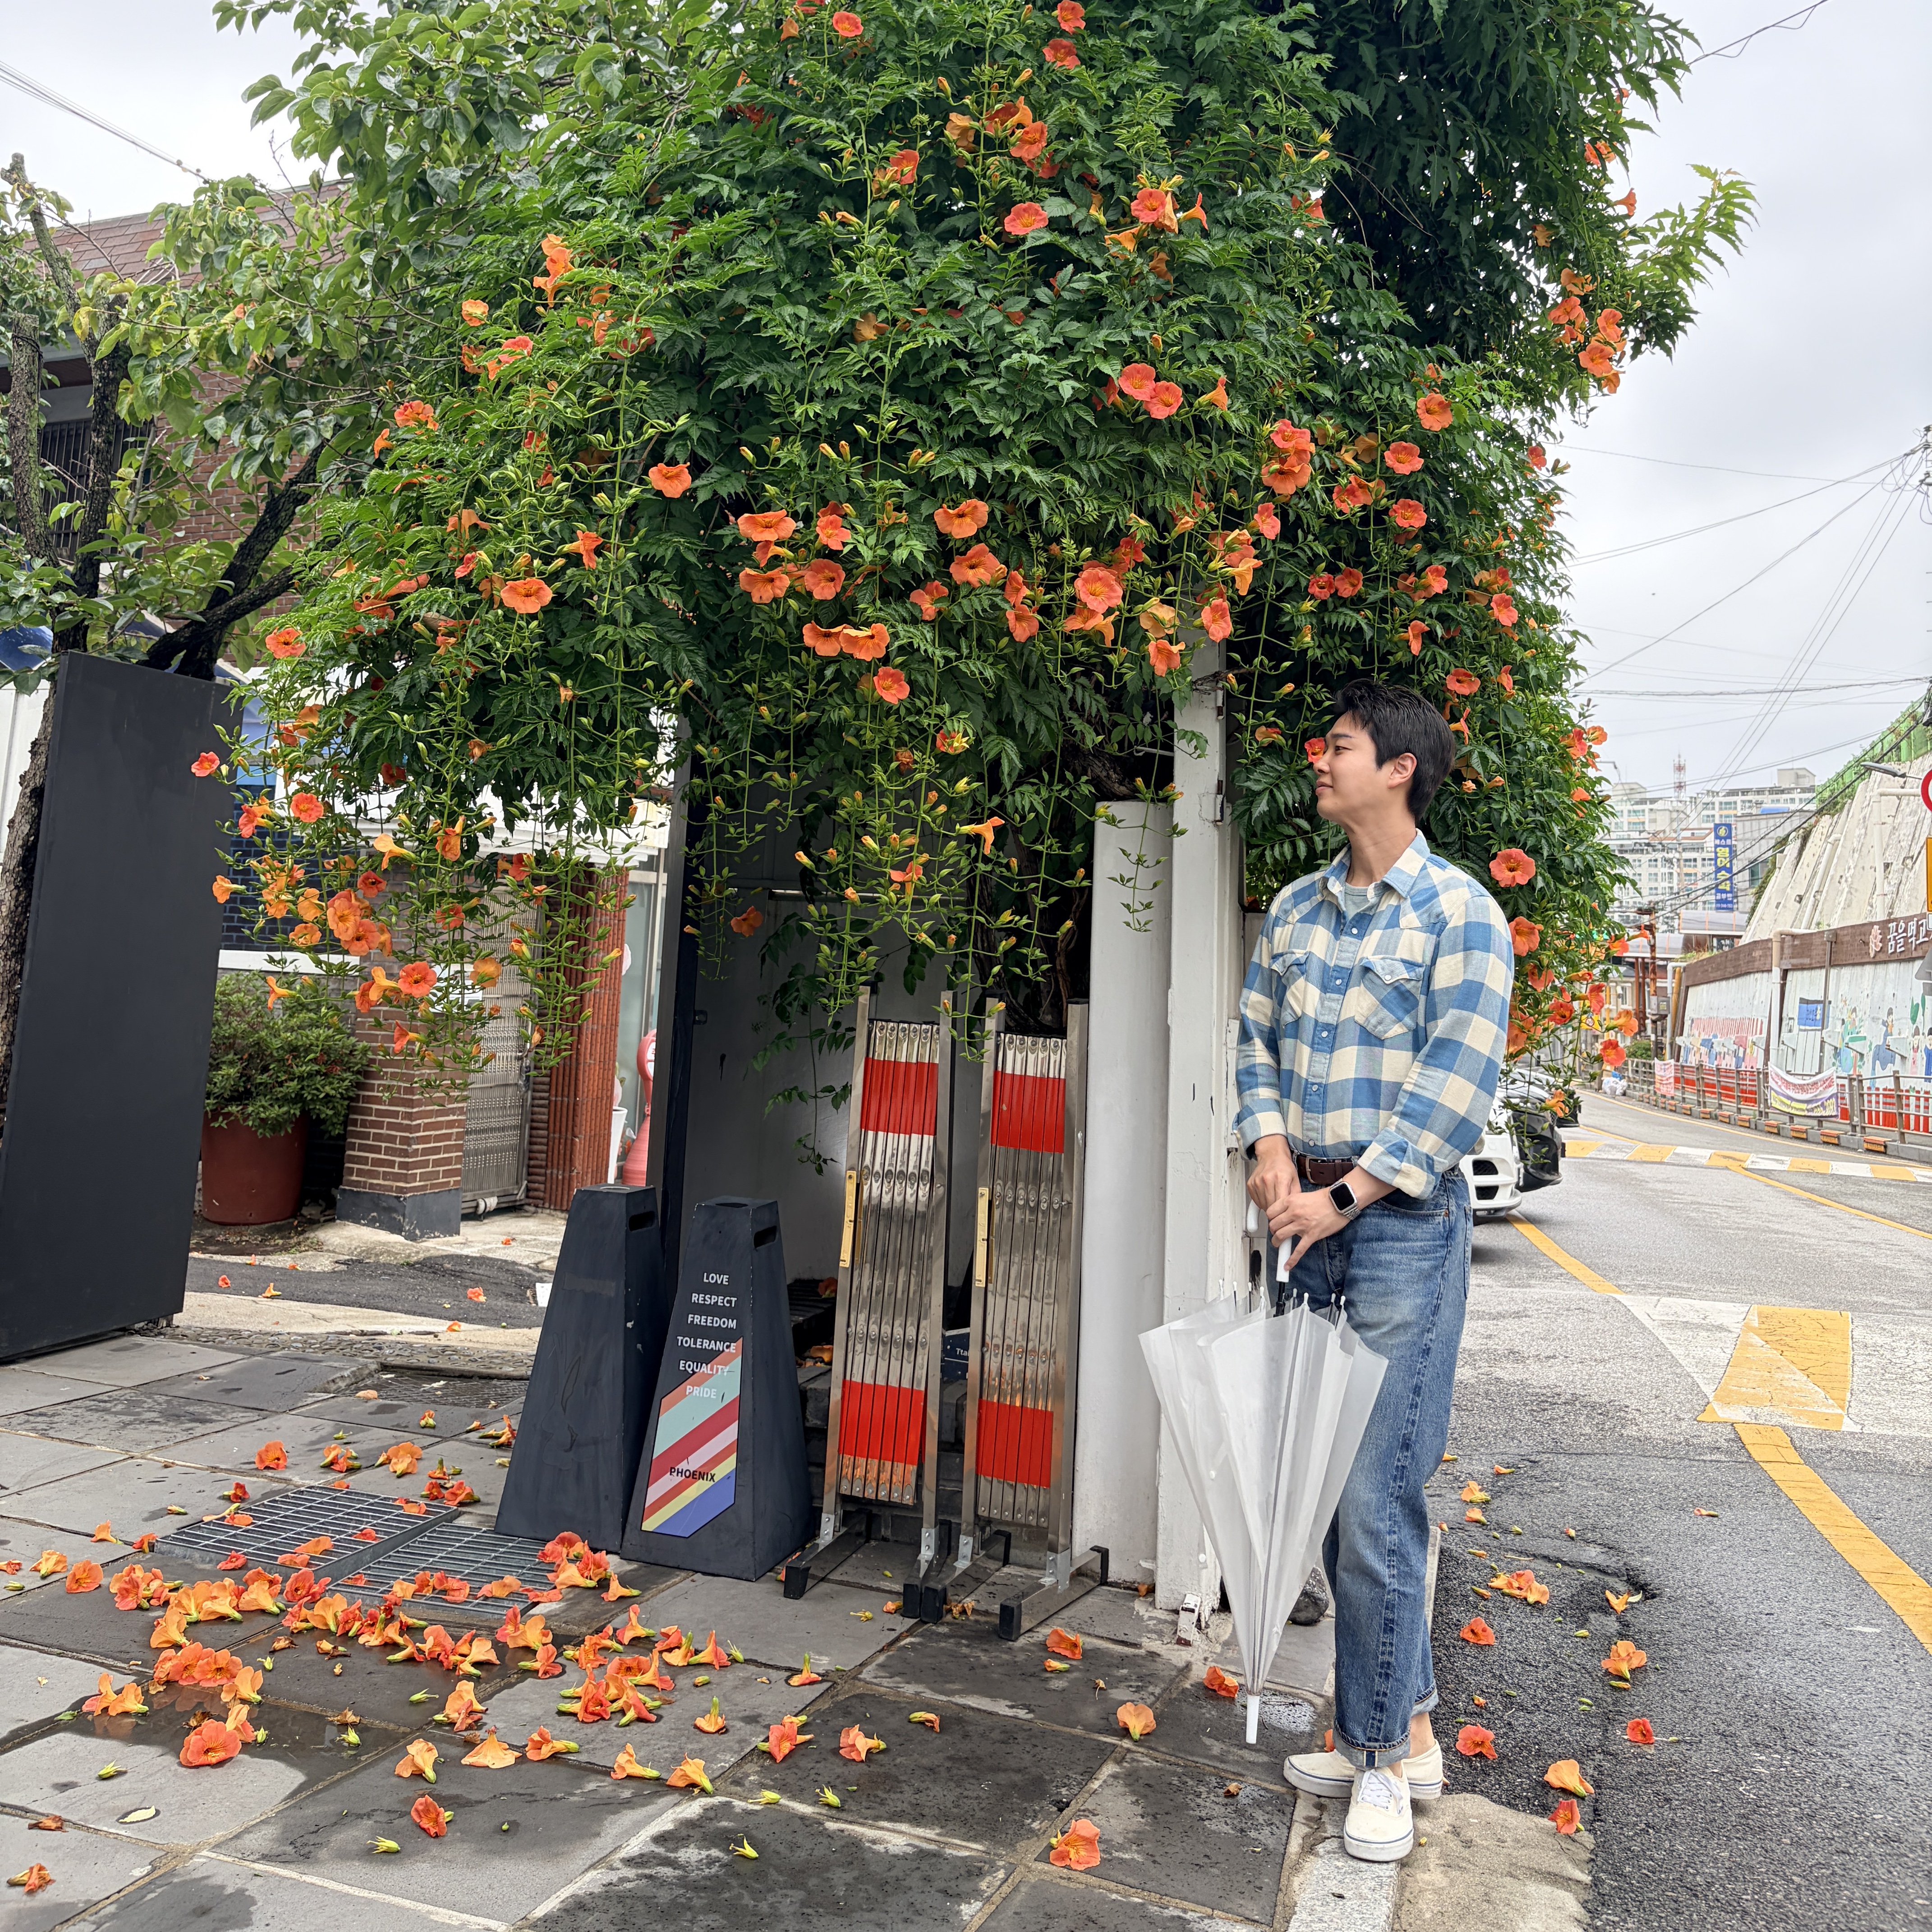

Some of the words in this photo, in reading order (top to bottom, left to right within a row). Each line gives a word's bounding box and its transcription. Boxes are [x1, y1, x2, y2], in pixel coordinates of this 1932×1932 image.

[704, 1272, 729, 1285] LOVE
[691, 1293, 737, 1307] RESPECT
[688, 1314, 737, 1329] FREEDOM
[676, 1336, 736, 1353] TOLERANCE
[956, 1348, 969, 1357] Tta
[679, 1360, 729, 1376] EQUALITY
[686, 1385, 717, 1399] PRIDE
[669, 1466, 716, 1483] PHOENIX
